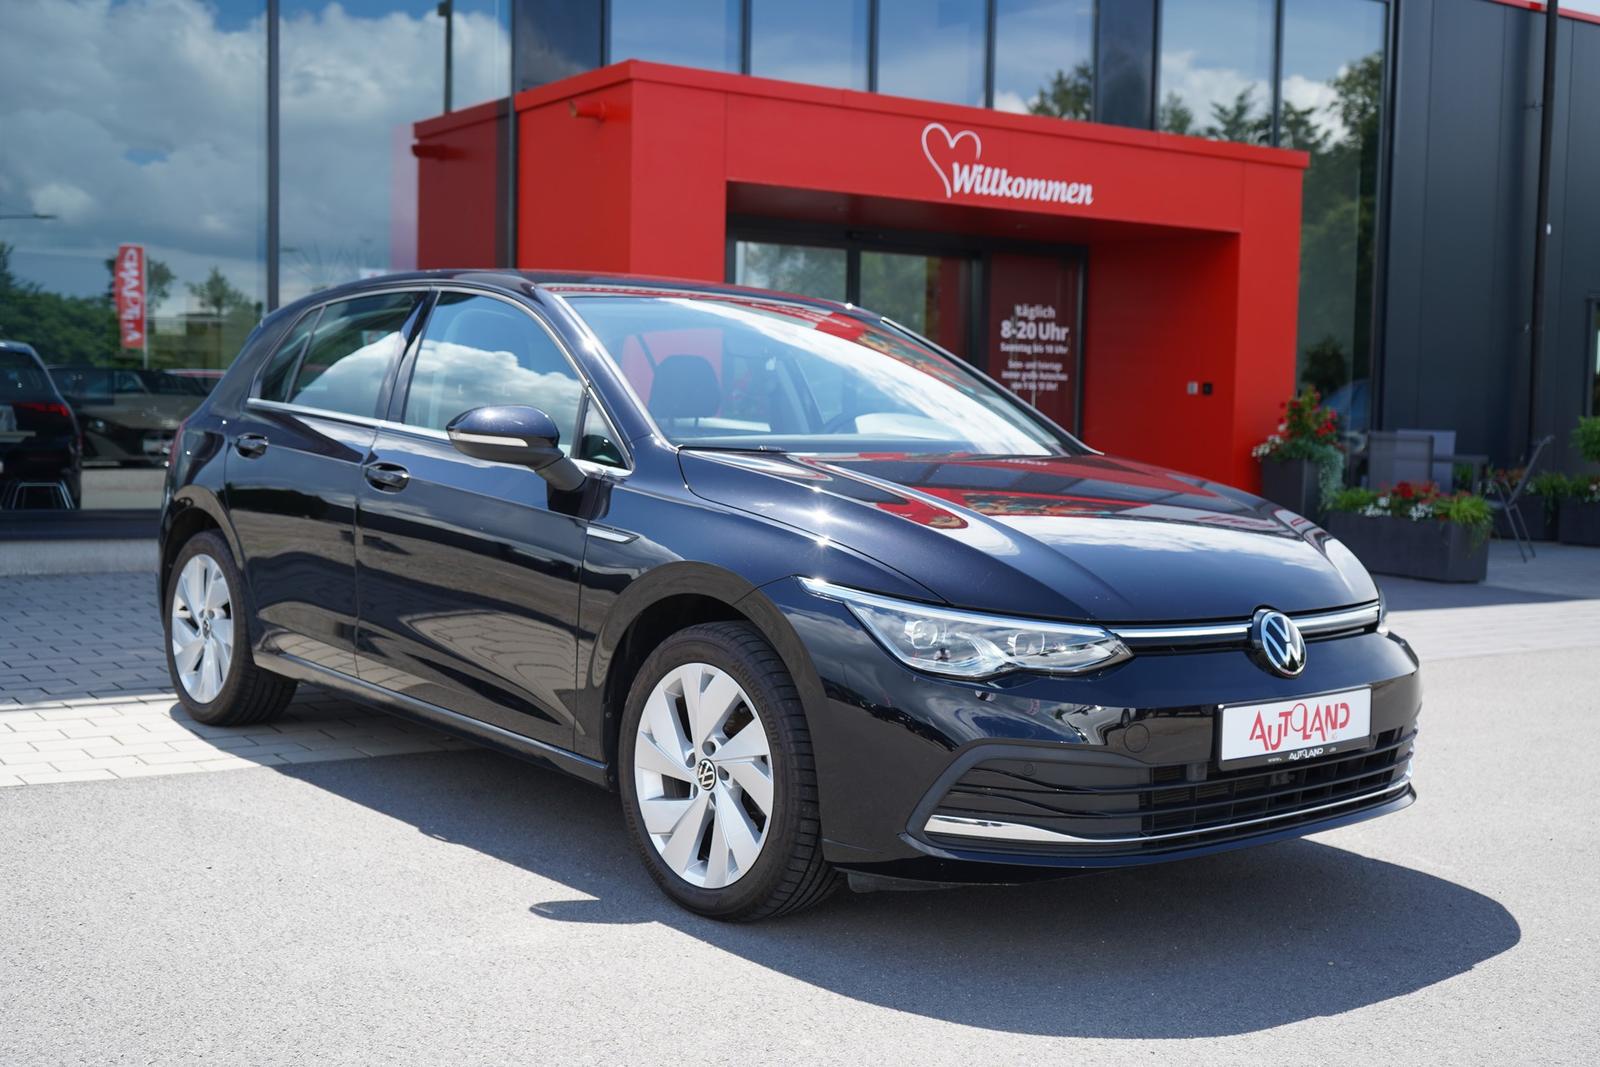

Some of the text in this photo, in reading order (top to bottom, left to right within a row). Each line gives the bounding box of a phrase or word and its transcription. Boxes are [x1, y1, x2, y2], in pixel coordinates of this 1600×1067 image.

[952, 161, 1094, 205] Willkommen
[1001, 320, 1069, 341] 8-20 Uhr
[1014, 303, 1056, 320] täglich
[1261, 611, 1307, 675] VW
[1249, 702, 1350, 751] AUTOLAND
